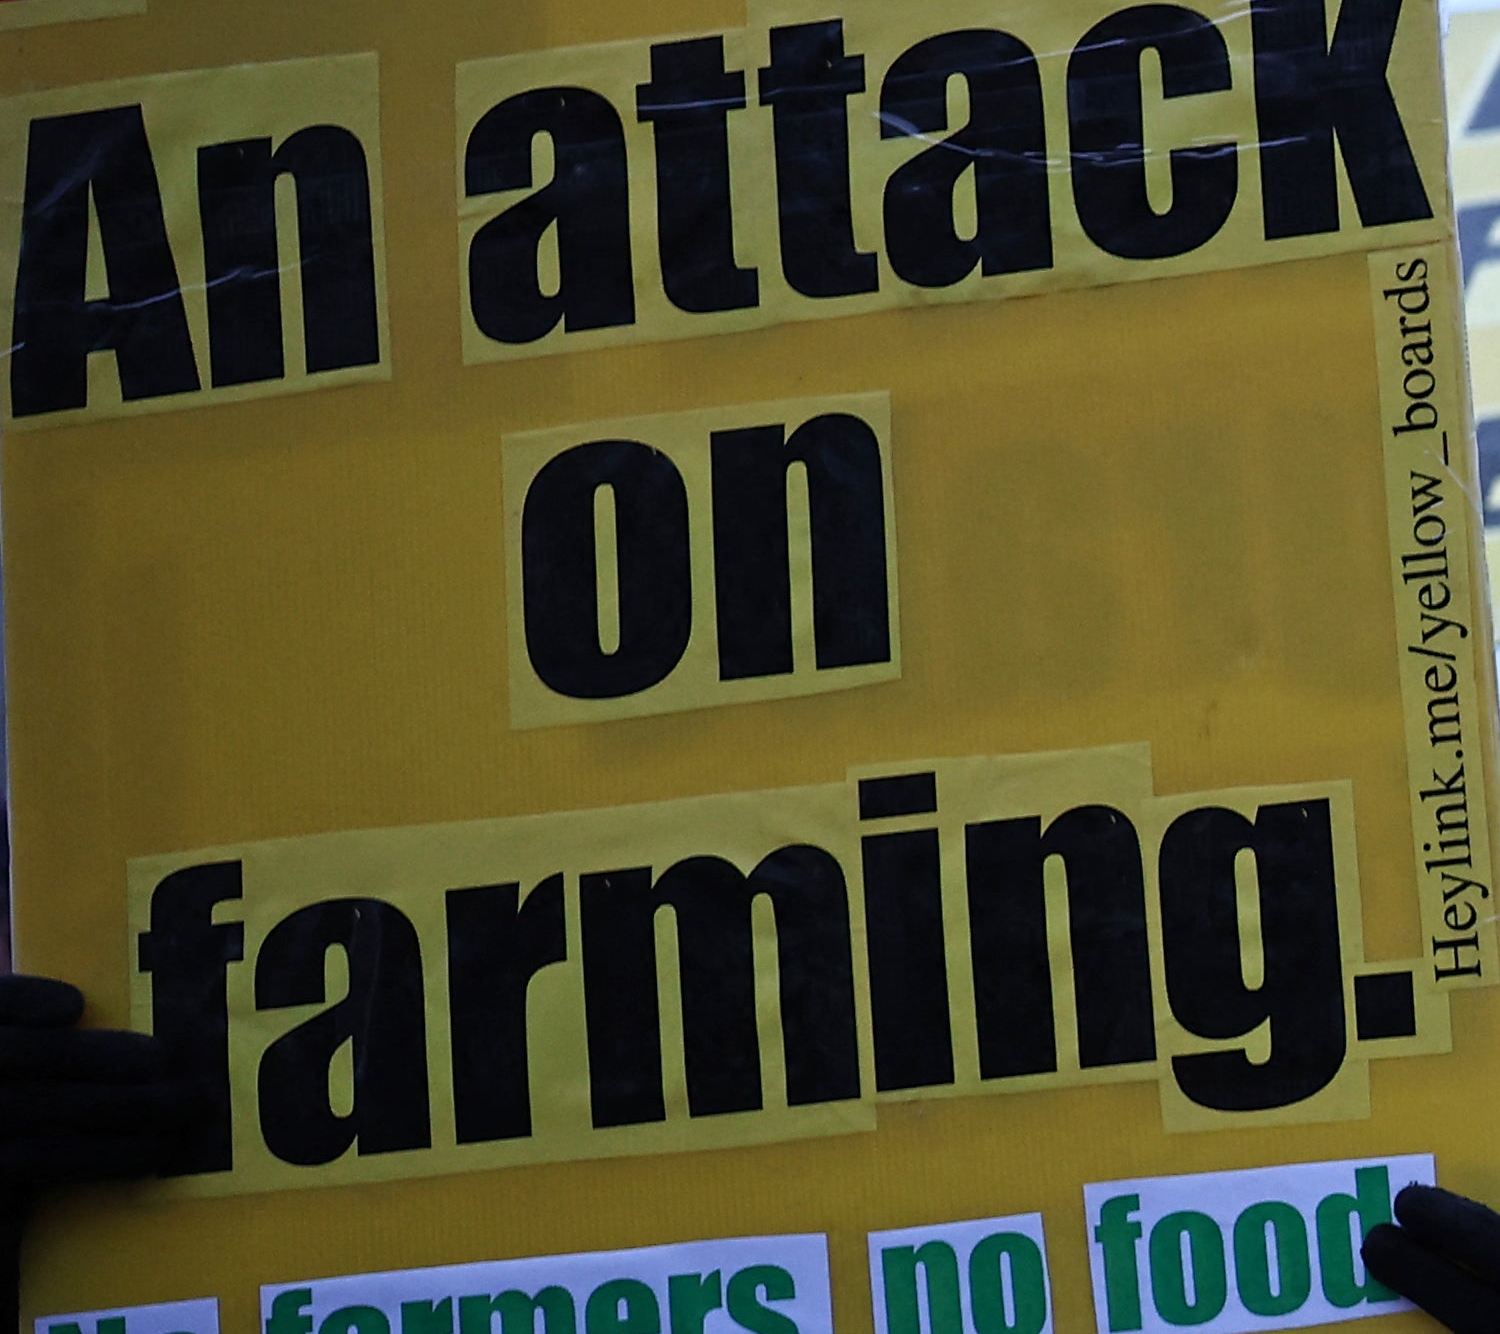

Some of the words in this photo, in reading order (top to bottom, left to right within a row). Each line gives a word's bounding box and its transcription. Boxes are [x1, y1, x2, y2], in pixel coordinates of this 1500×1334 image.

[10, 102, 379, 417] An
[519, 409, 891, 701] on
[1384, 257, 1488, 982] Heylink.me/yellow_boards
[137, 770, 1417, 1178] farming.
[1095, 1165, 1400, 1332] food
